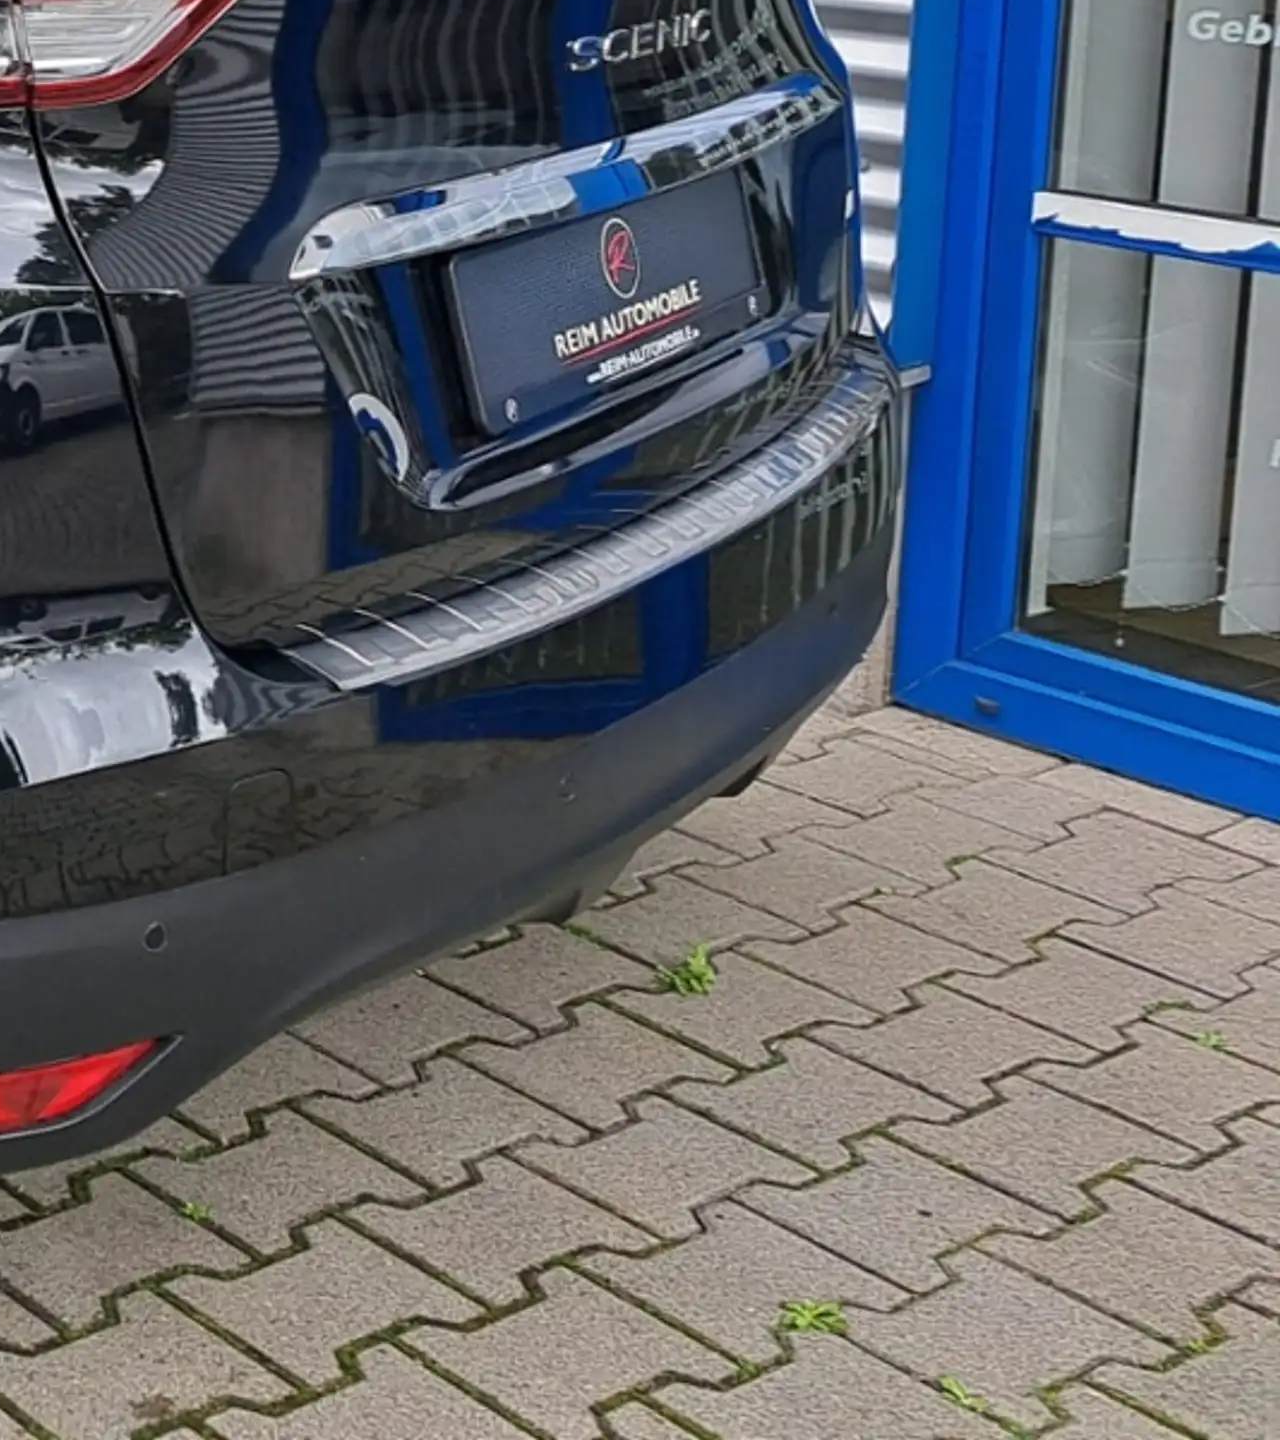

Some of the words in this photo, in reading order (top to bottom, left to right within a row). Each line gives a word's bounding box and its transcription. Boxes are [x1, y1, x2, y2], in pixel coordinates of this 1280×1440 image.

[565, 7, 712, 72] SCENIC
[553, 320, 600, 359] REIM
[600, 278, 703, 342] AUTOMOBILE
